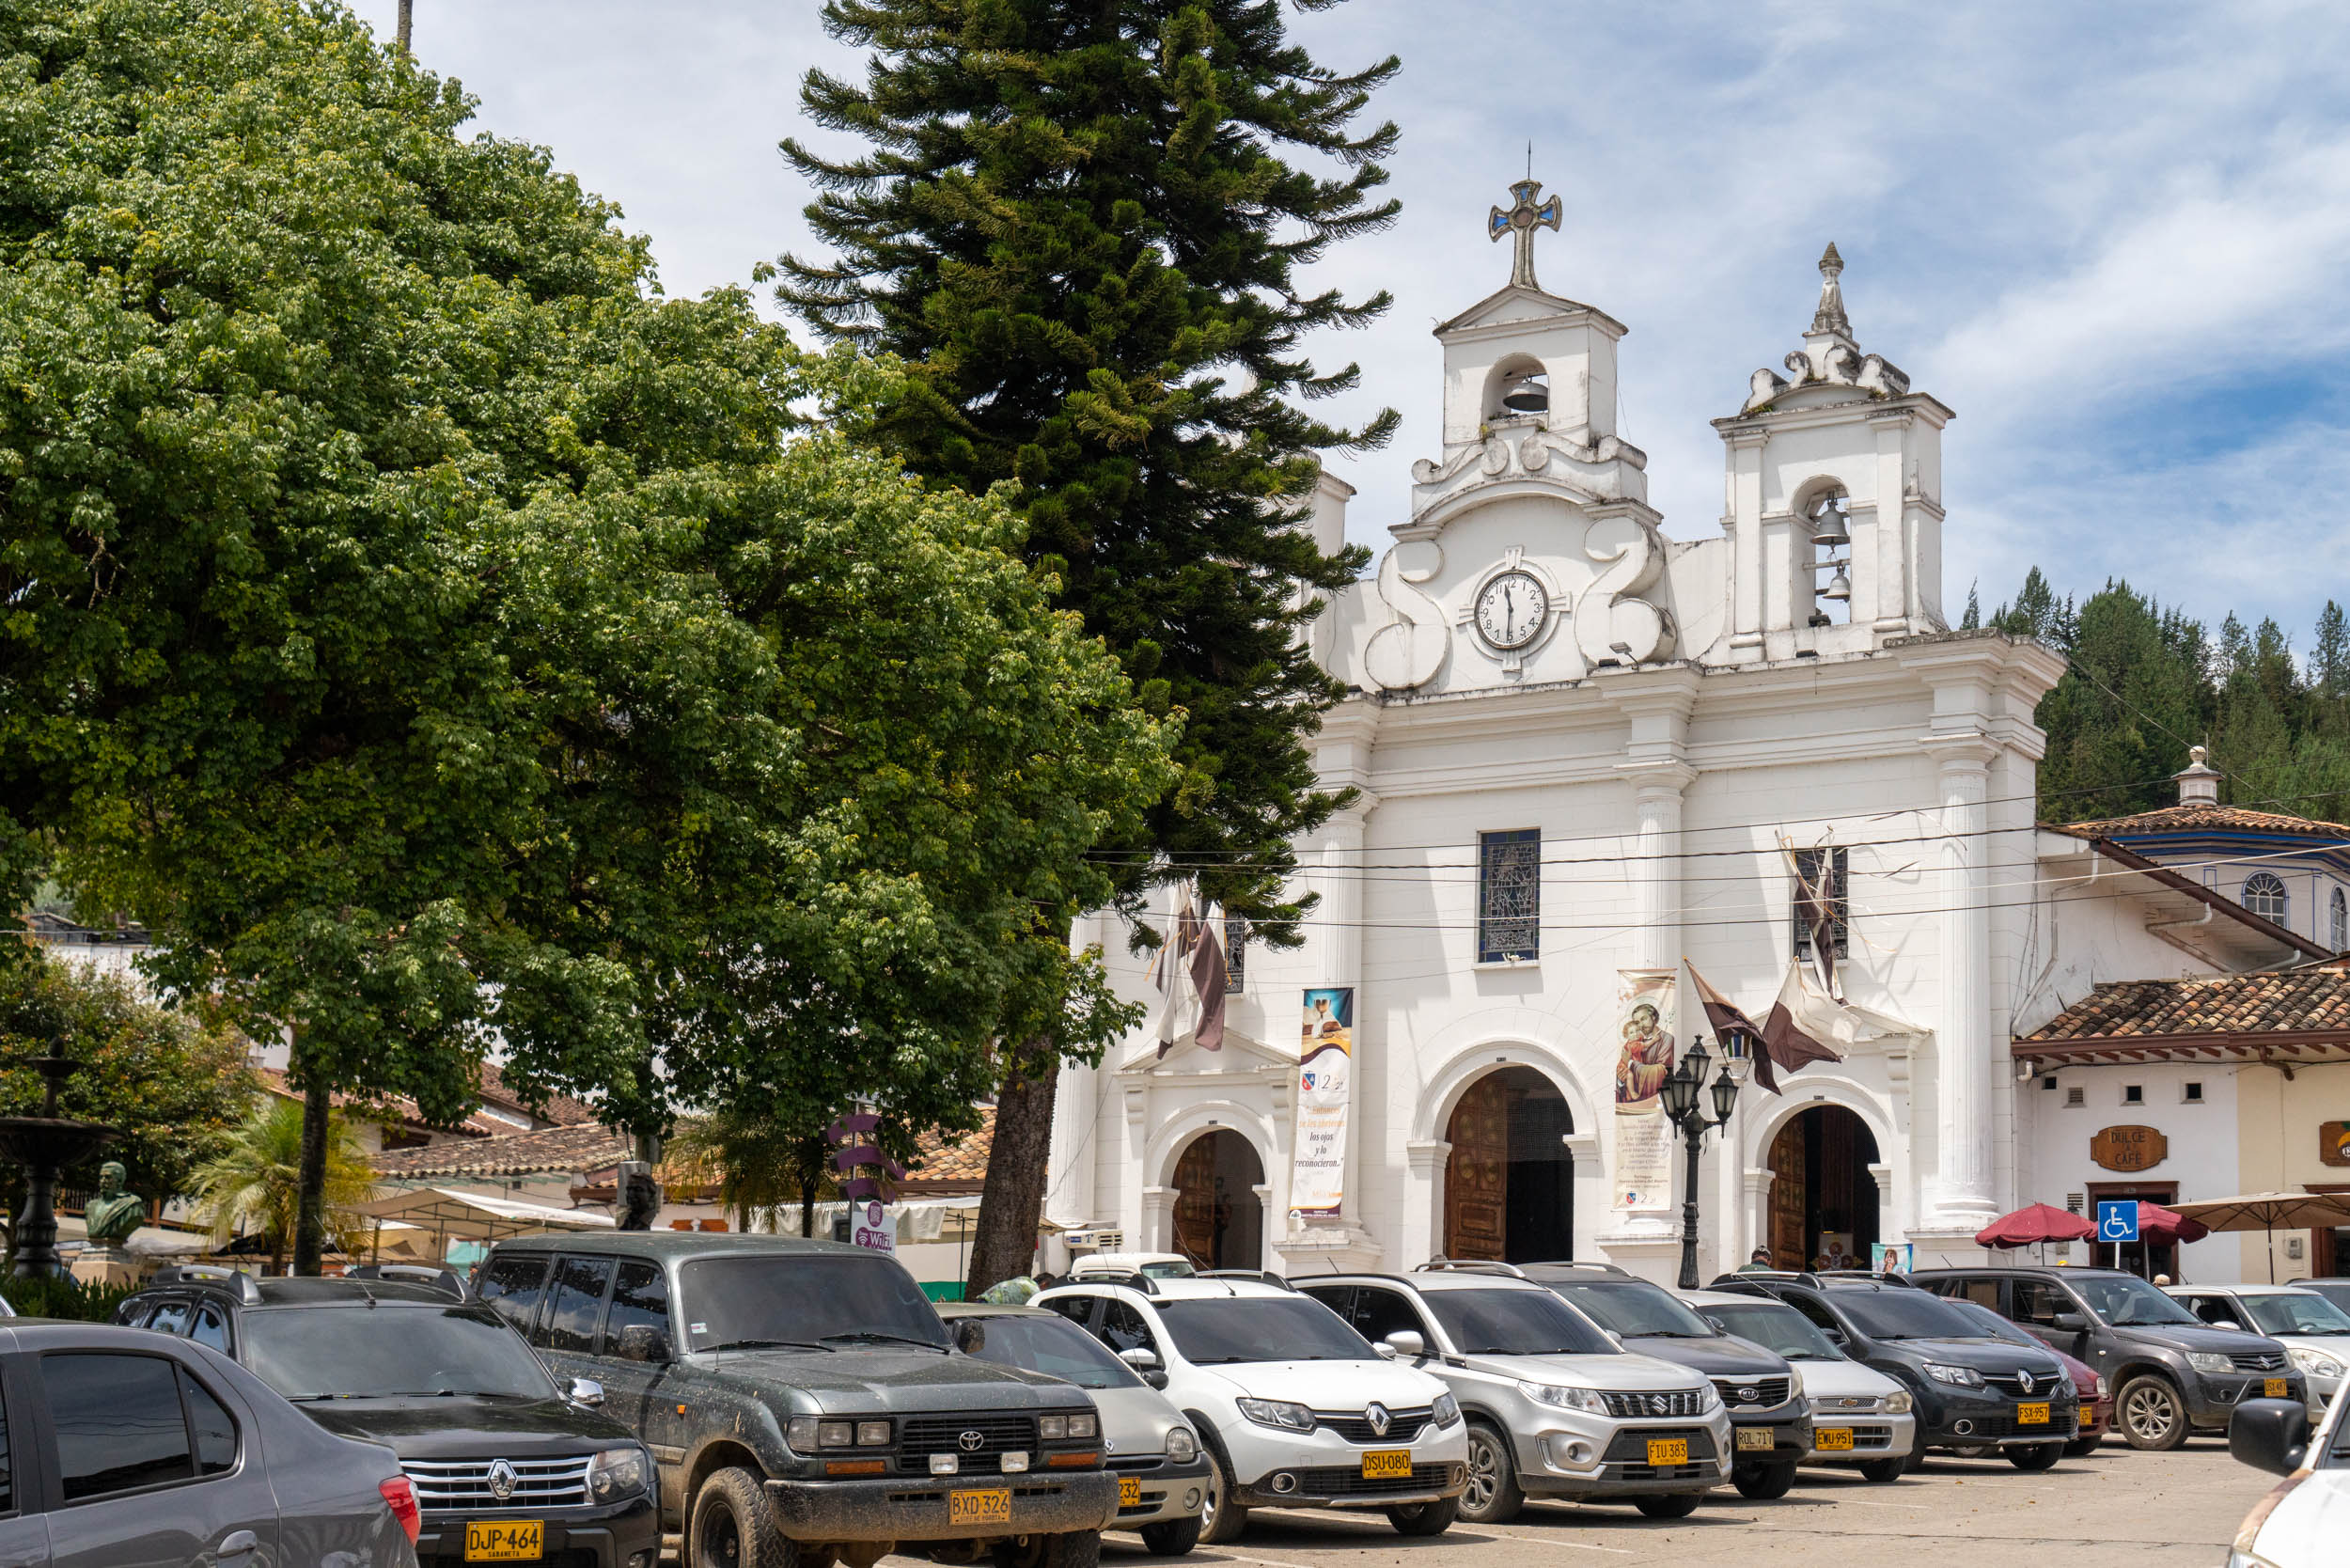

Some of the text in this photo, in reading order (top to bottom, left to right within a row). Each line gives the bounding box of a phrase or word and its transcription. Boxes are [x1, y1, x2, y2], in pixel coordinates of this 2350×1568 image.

[1508, 578, 1516, 588] 12
[1496, 584, 1502, 594] 11
[1529, 589, 1537, 600] 2
[1486, 594, 1495, 605] 10
[1482, 607, 1489, 618] 9
[1533, 603, 1541, 613] 3
[1486, 619, 1492, 629] 8
[1528, 617, 1535, 626] 4
[1520, 625, 1527, 635] 5
[1309, 1131, 1334, 1143] los ojos
[2111, 1131, 2145, 1143] DULCE
[1314, 1145, 1327, 1157] y lo
[870, 1232, 892, 1247] WiFi
[1757, 1432, 1773, 1445] 717
[1650, 1443, 1686, 1459] FIU 383
